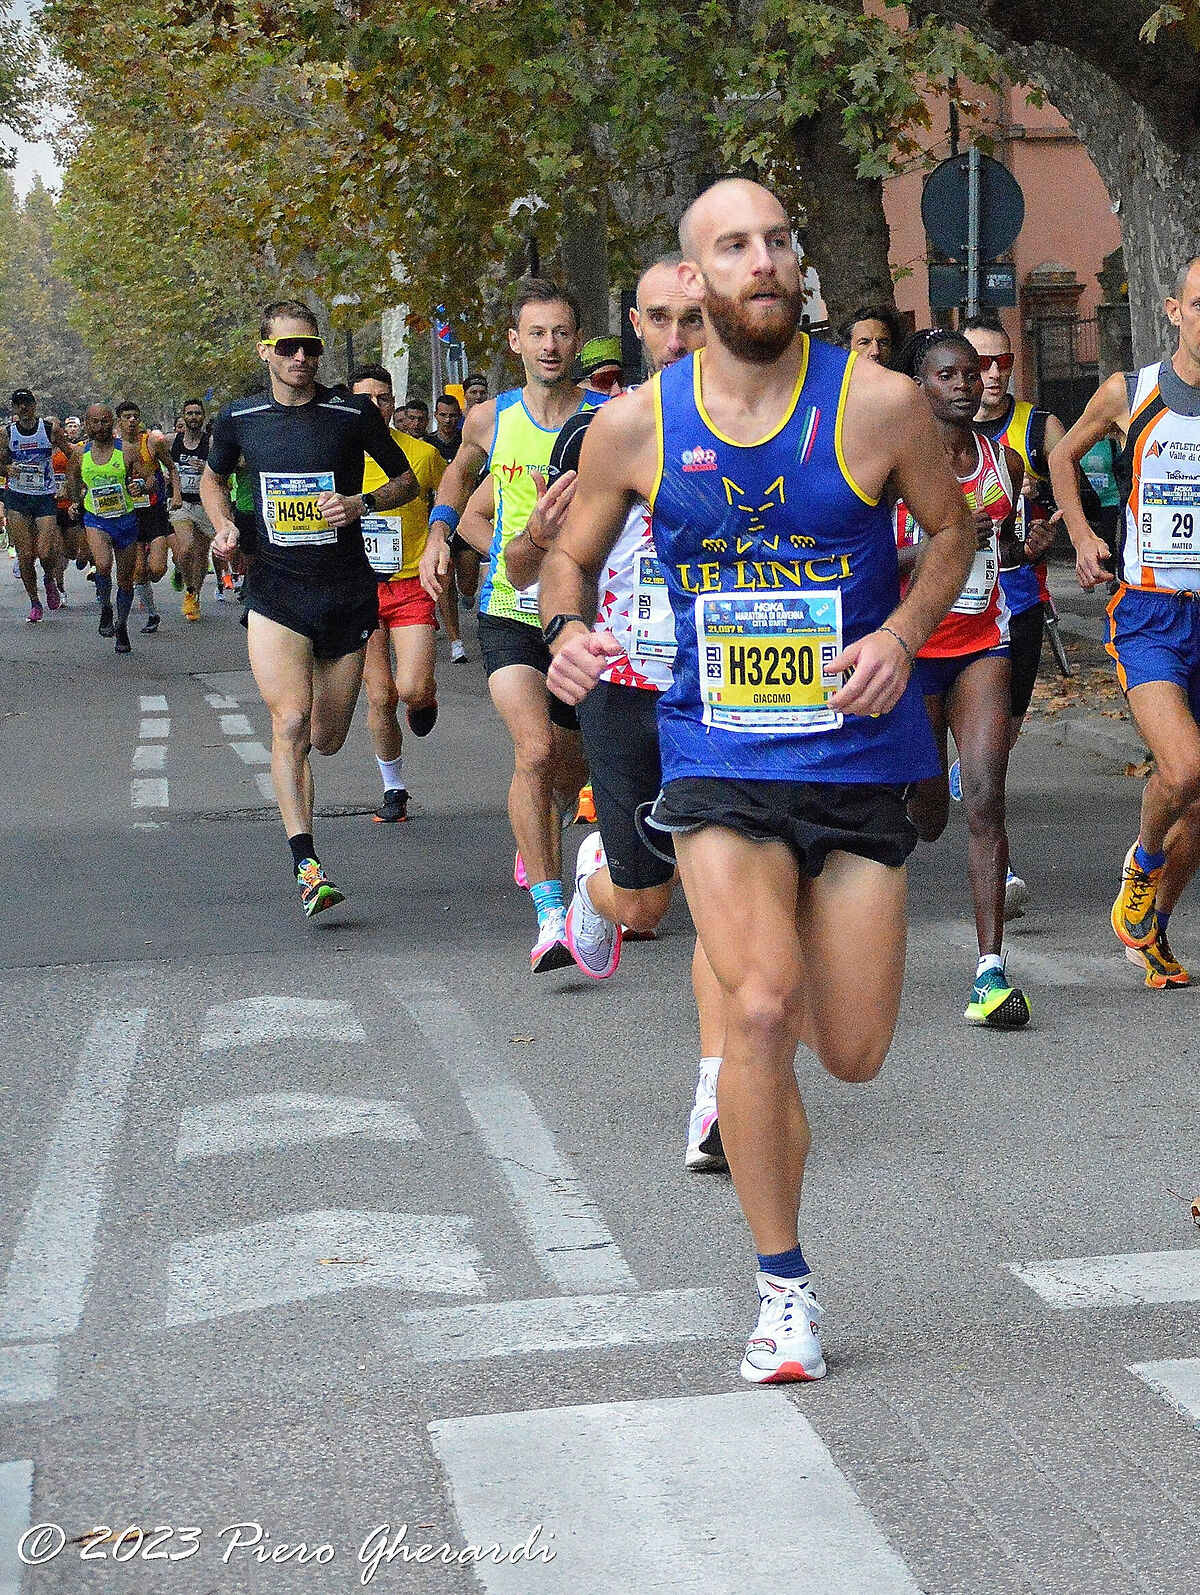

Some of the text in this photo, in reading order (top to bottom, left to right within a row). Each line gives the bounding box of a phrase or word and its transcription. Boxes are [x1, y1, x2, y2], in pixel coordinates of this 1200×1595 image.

[1169, 451, 1187, 461] Valle
[1188, 453, 1197, 462] di
[278, 501, 323, 522] H4943
[1171, 513, 1194, 538] 29
[676, 553, 854, 595] LE LINCI
[753, 602, 785, 612] HOKA
[735, 611, 768, 621] MARATONA
[776, 611, 805, 620] RAVENNA
[729, 645, 814, 686] H3230
[753, 693, 791, 704] GIACOMO
